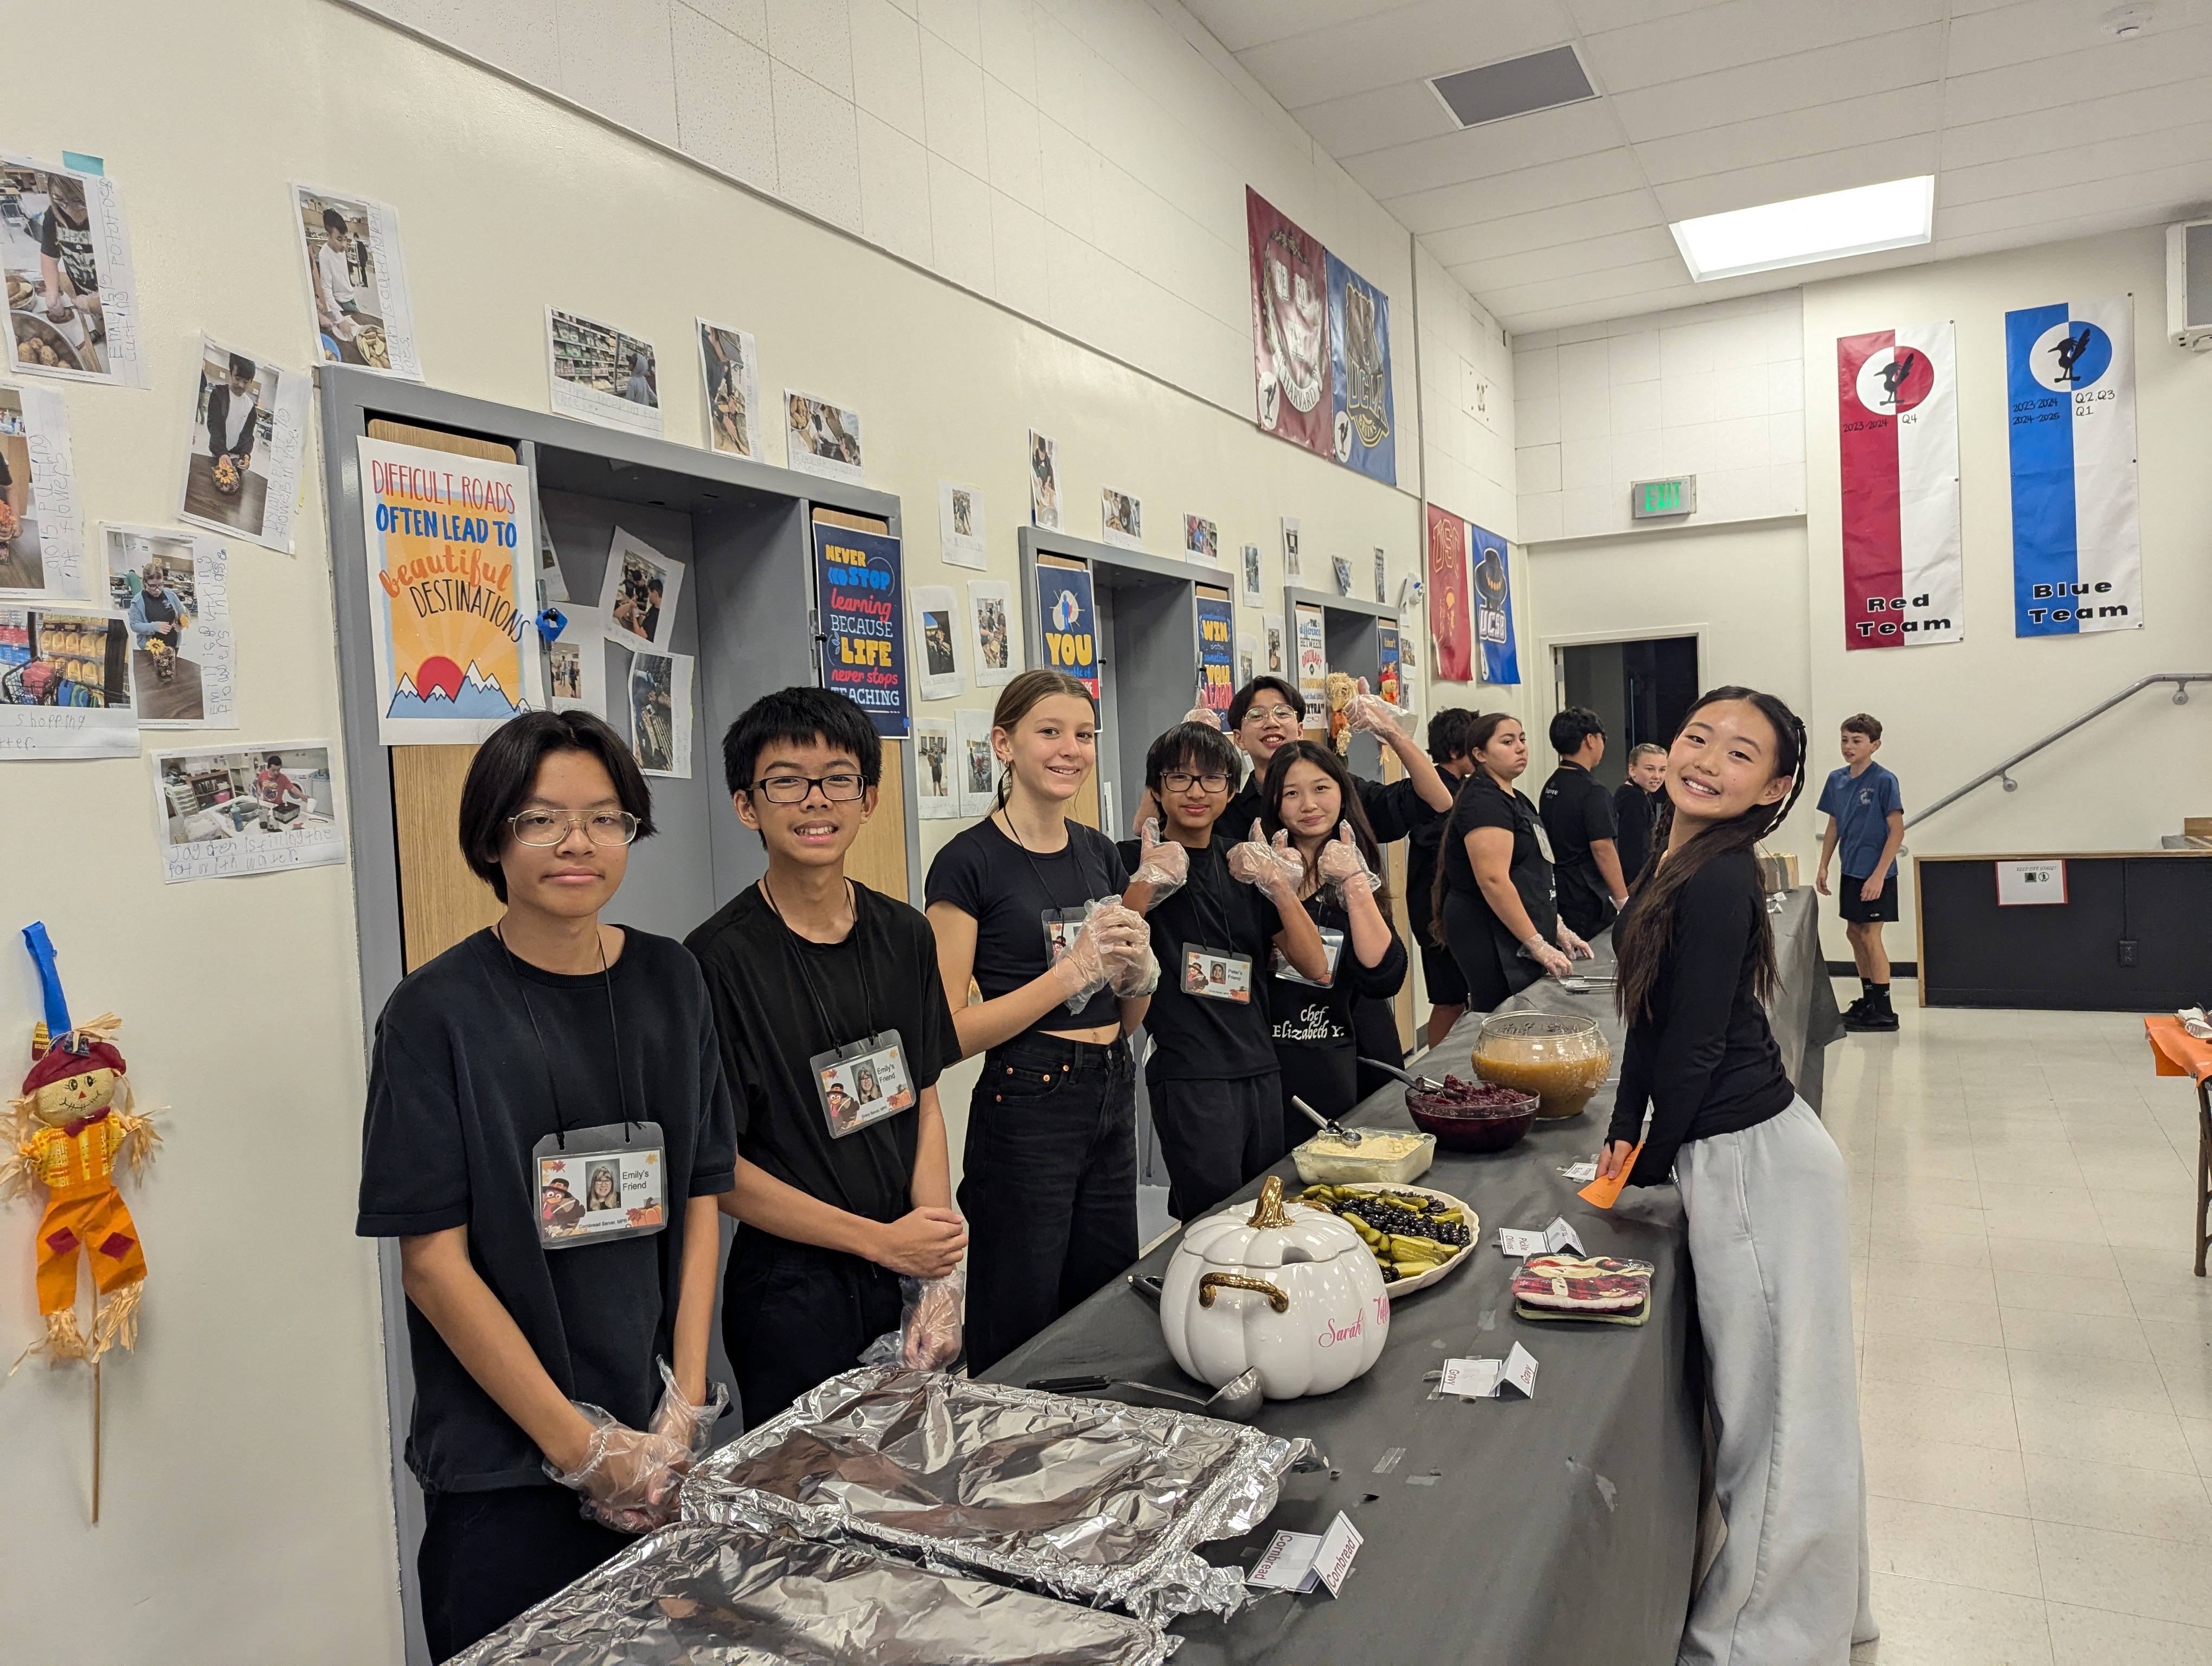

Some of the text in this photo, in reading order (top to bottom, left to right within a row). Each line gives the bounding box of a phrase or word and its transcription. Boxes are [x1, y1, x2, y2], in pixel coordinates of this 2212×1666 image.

[1283, 372, 1316, 411] HARVARD
[1348, 362, 1387, 425] UCLA
[1902, 414, 1918, 425] Q4
[2075, 406, 2094, 417] Q1
[1359, 414, 1378, 437] BRUINS
[372, 460, 516, 515] DIFFICULT ROADS
[1645, 482, 1681, 511] EXIT
[376, 503, 517, 548] OFTEN LEAD TO
[825, 544, 866, 567] NEVER
[1433, 518, 1460, 579] USC
[378, 544, 512, 598] beautiful
[848, 566, 891, 591] STOP
[2033, 580, 2113, 600] Blue
[215, 600, 227, 614] in
[409, 578, 531, 643] DESTINATIONS
[830, 587, 892, 623] learning
[1867, 593, 1930, 613] Red
[2028, 603, 2129, 624] Team
[830, 614, 893, 638] BECAUSE
[1202, 620, 1229, 642] WIN
[1300, 623, 1321, 639] difference
[1480, 608, 1506, 639] UCSB
[1856, 617, 1951, 638] Team
[841, 636, 892, 667] LIFE
[1045, 632, 1092, 666] YOU
[1300, 637, 1322, 649] BETWEEN
[1302, 650, 1322, 669] ORDINARY
[831, 666, 898, 689] never stops
[1204, 664, 1230, 685] YOU
[1205, 682, 1233, 709] LEARN
[17, 713, 85, 729] shopping
[1272, 1020, 1345, 1040] Elizabeth Y.
[877, 1063, 895, 1075] Emily's
[879, 1073, 896, 1084] Friend
[622, 1169, 649, 1181] Emily's
[622, 1181, 647, 1191] Friend
[1505, 1235, 1514, 1250] Olives
[1518, 1236, 1528, 1251] Pickle
[1319, 1308, 1364, 1348] Sarah
[1444, 1369, 1460, 1386] Gravy
[1520, 1364, 1534, 1384] Gravy
[1254, 1535, 1293, 1580] Cornbread
[1326, 1535, 1356, 1588] Cornbread
